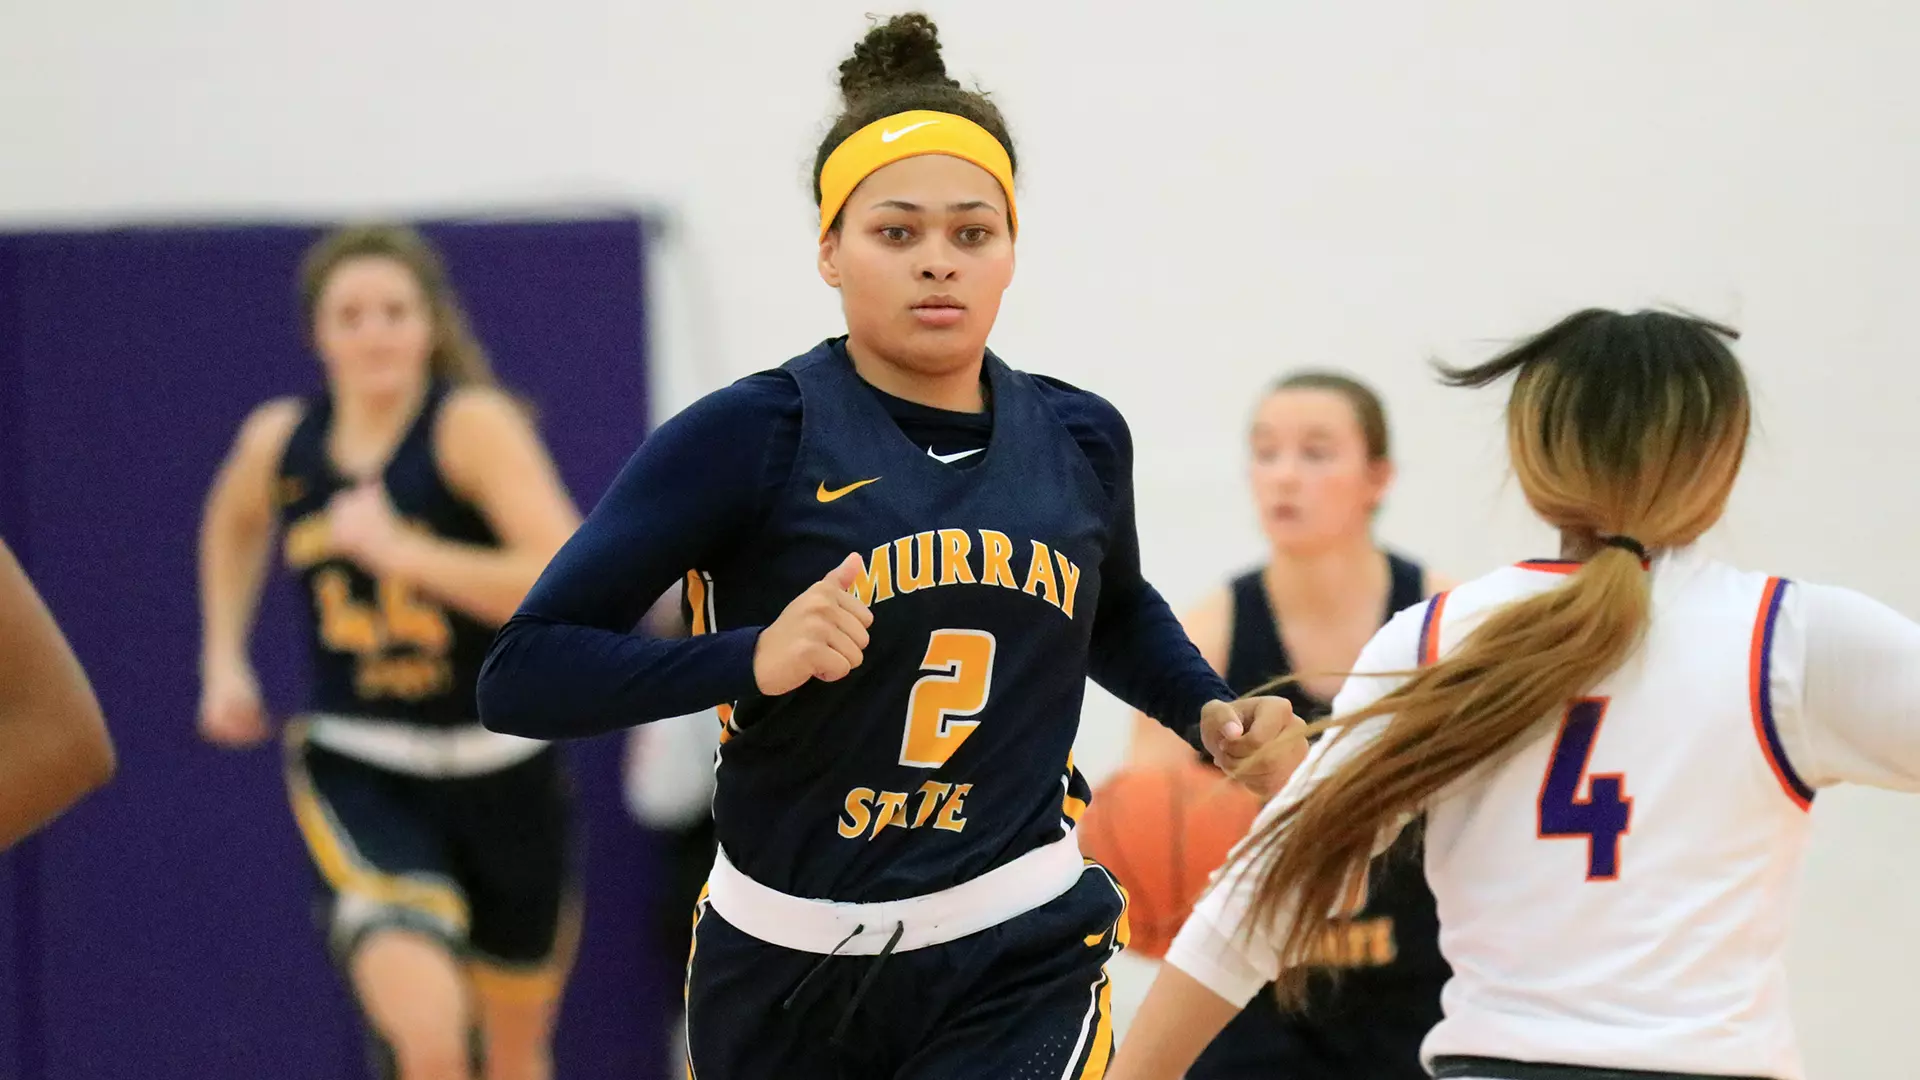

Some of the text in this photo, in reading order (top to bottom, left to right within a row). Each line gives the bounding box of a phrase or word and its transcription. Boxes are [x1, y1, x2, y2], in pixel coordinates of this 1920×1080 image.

[849, 528, 1080, 620] MURRAY
[898, 628, 997, 769] 2
[1537, 696, 1634, 882] 4
